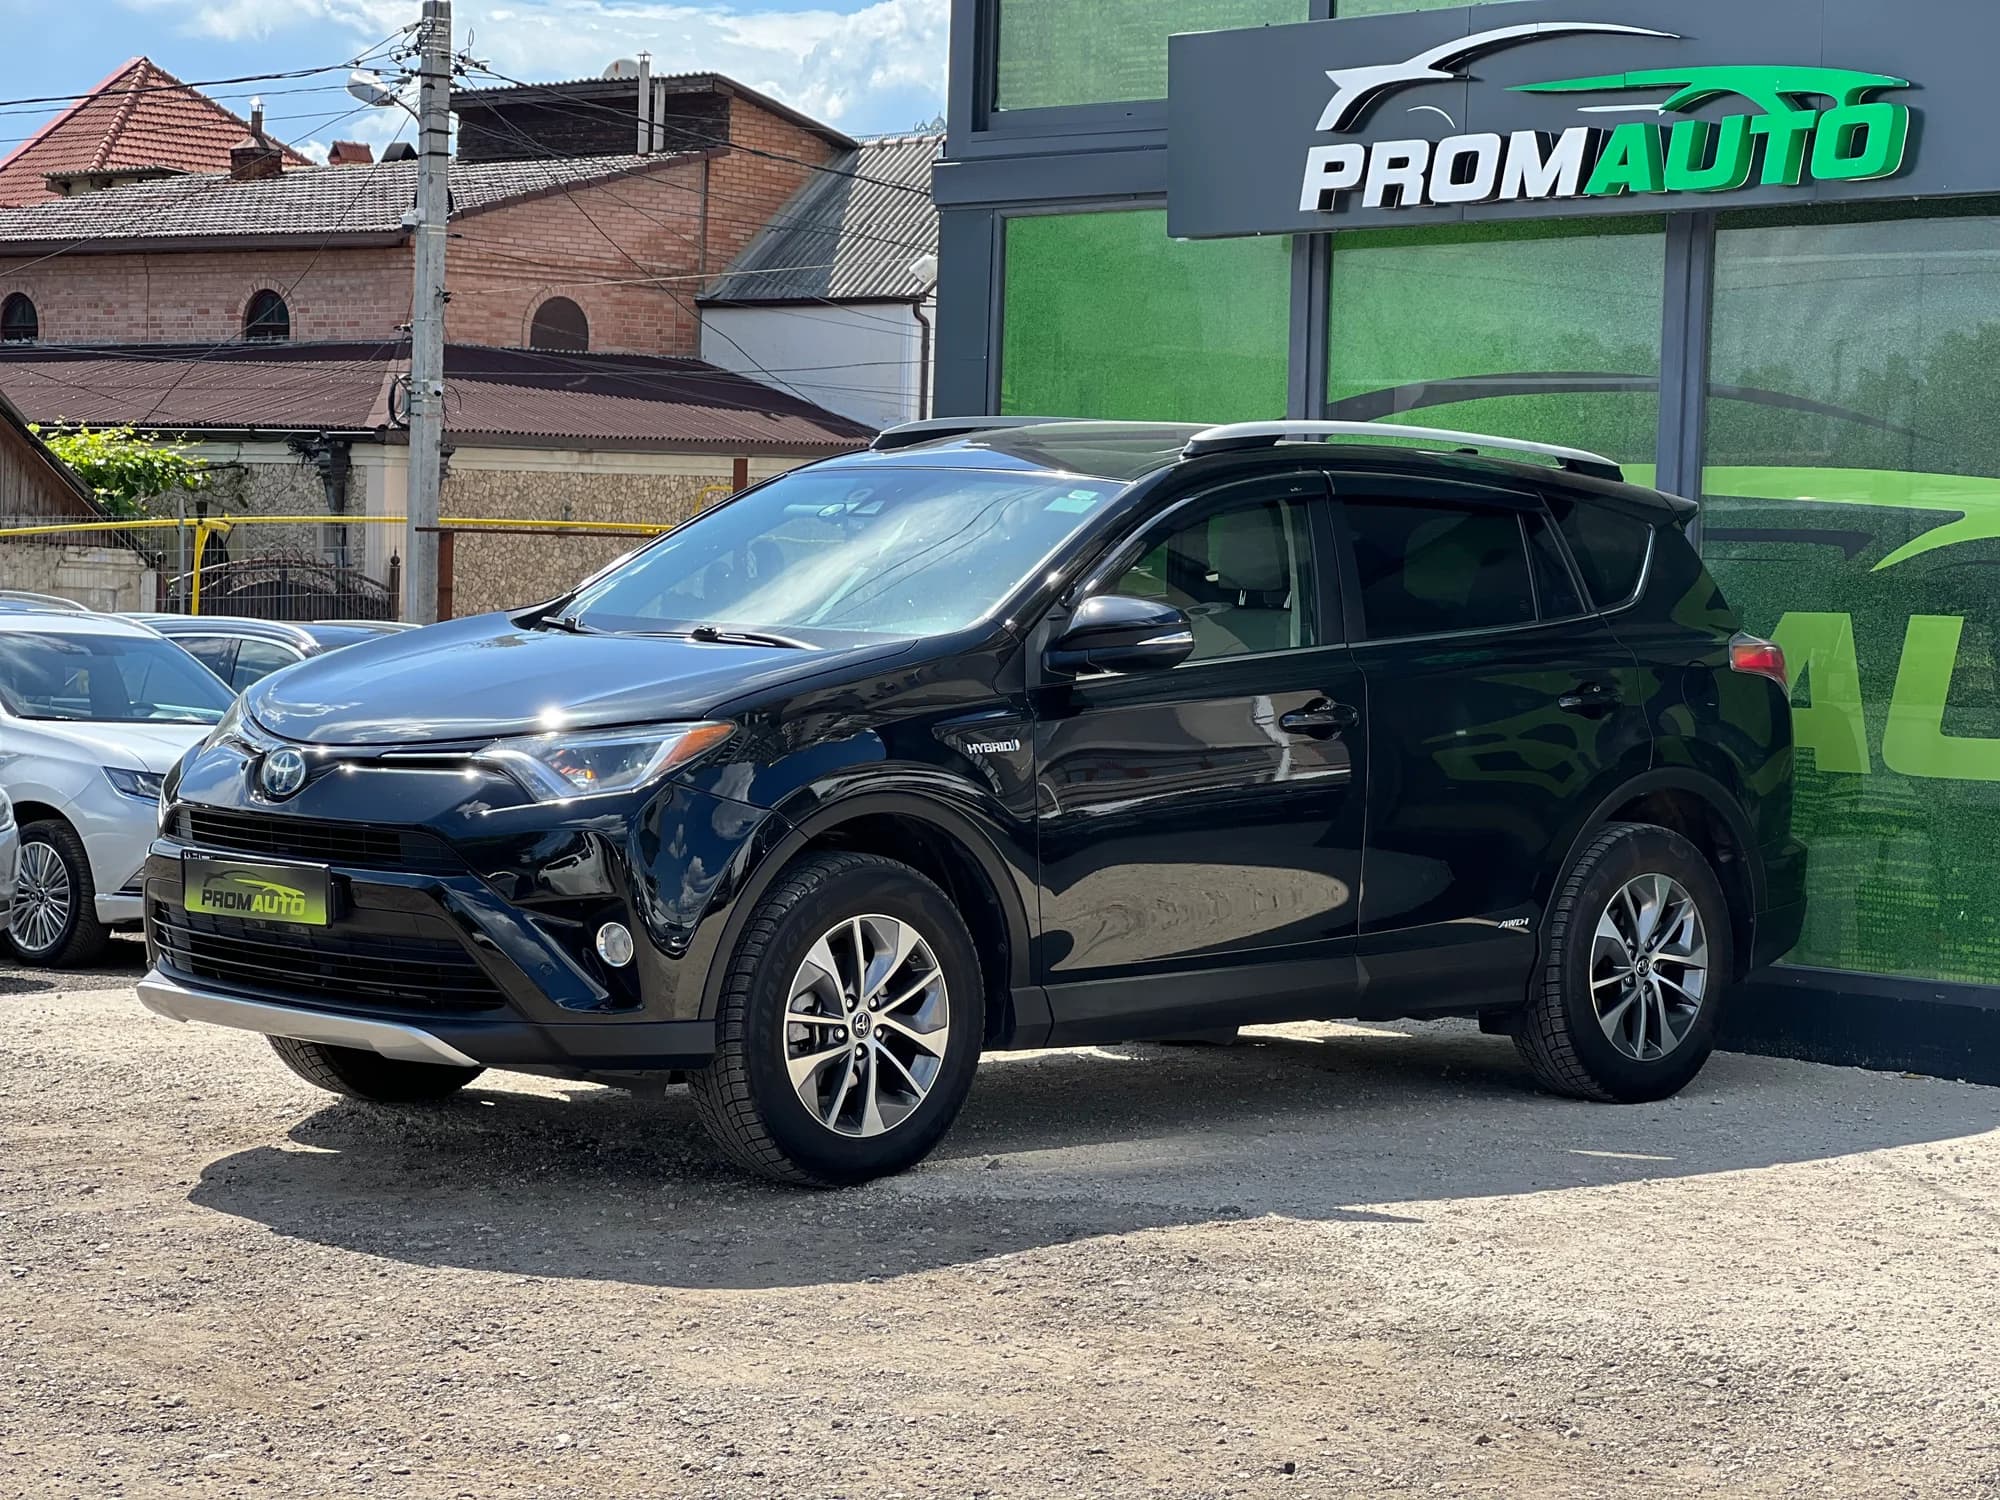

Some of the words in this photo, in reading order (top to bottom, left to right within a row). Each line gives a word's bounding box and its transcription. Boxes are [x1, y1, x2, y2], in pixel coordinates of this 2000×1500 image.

[1299, 104, 1909, 212] PROMAUTO
[966, 741, 1013, 754] HYBRID
[201, 888, 305, 916] PROMAUTO
